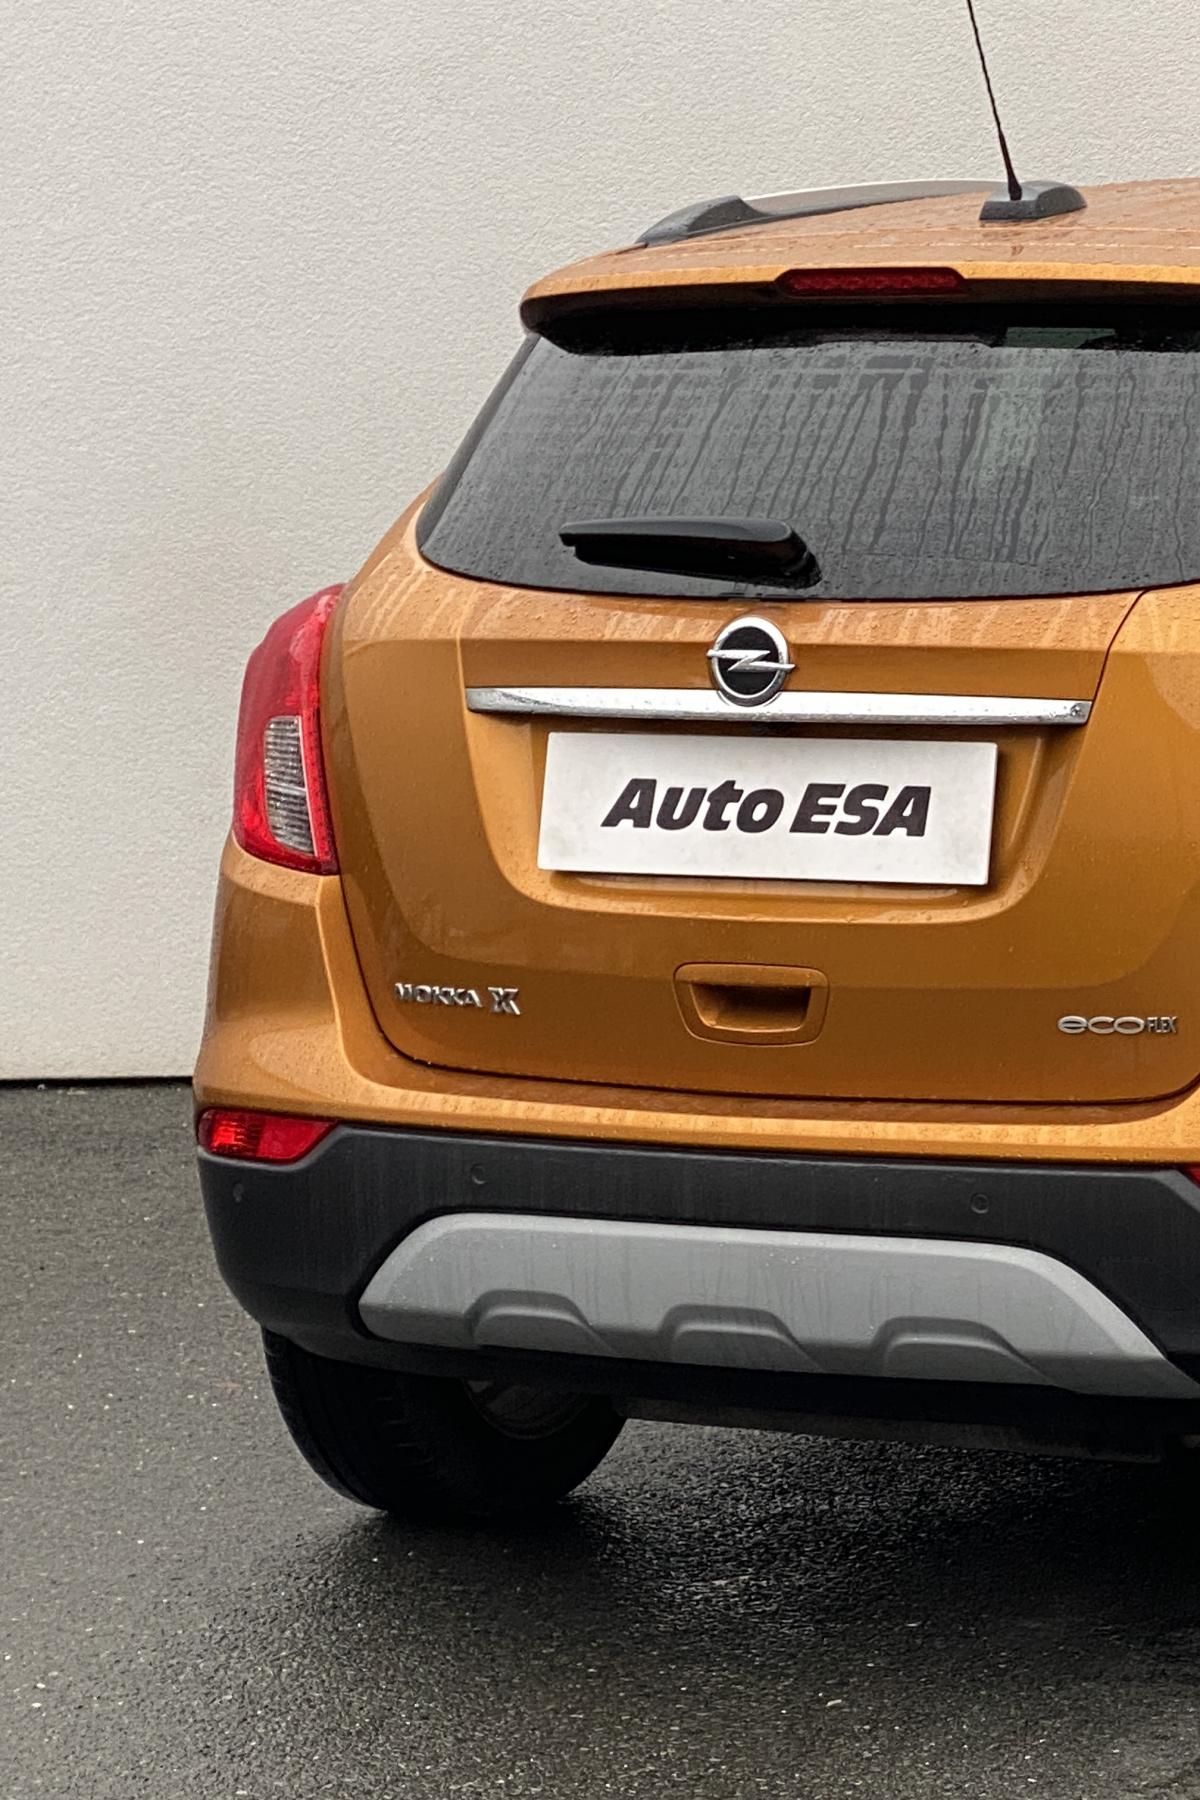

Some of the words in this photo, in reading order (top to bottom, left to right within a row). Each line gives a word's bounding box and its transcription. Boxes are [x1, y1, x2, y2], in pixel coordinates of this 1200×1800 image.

[601, 778, 785, 833] Auto
[790, 783, 932, 837] ESA
[395, 982, 483, 1008] MOKKA
[488, 986, 521, 1015] X
